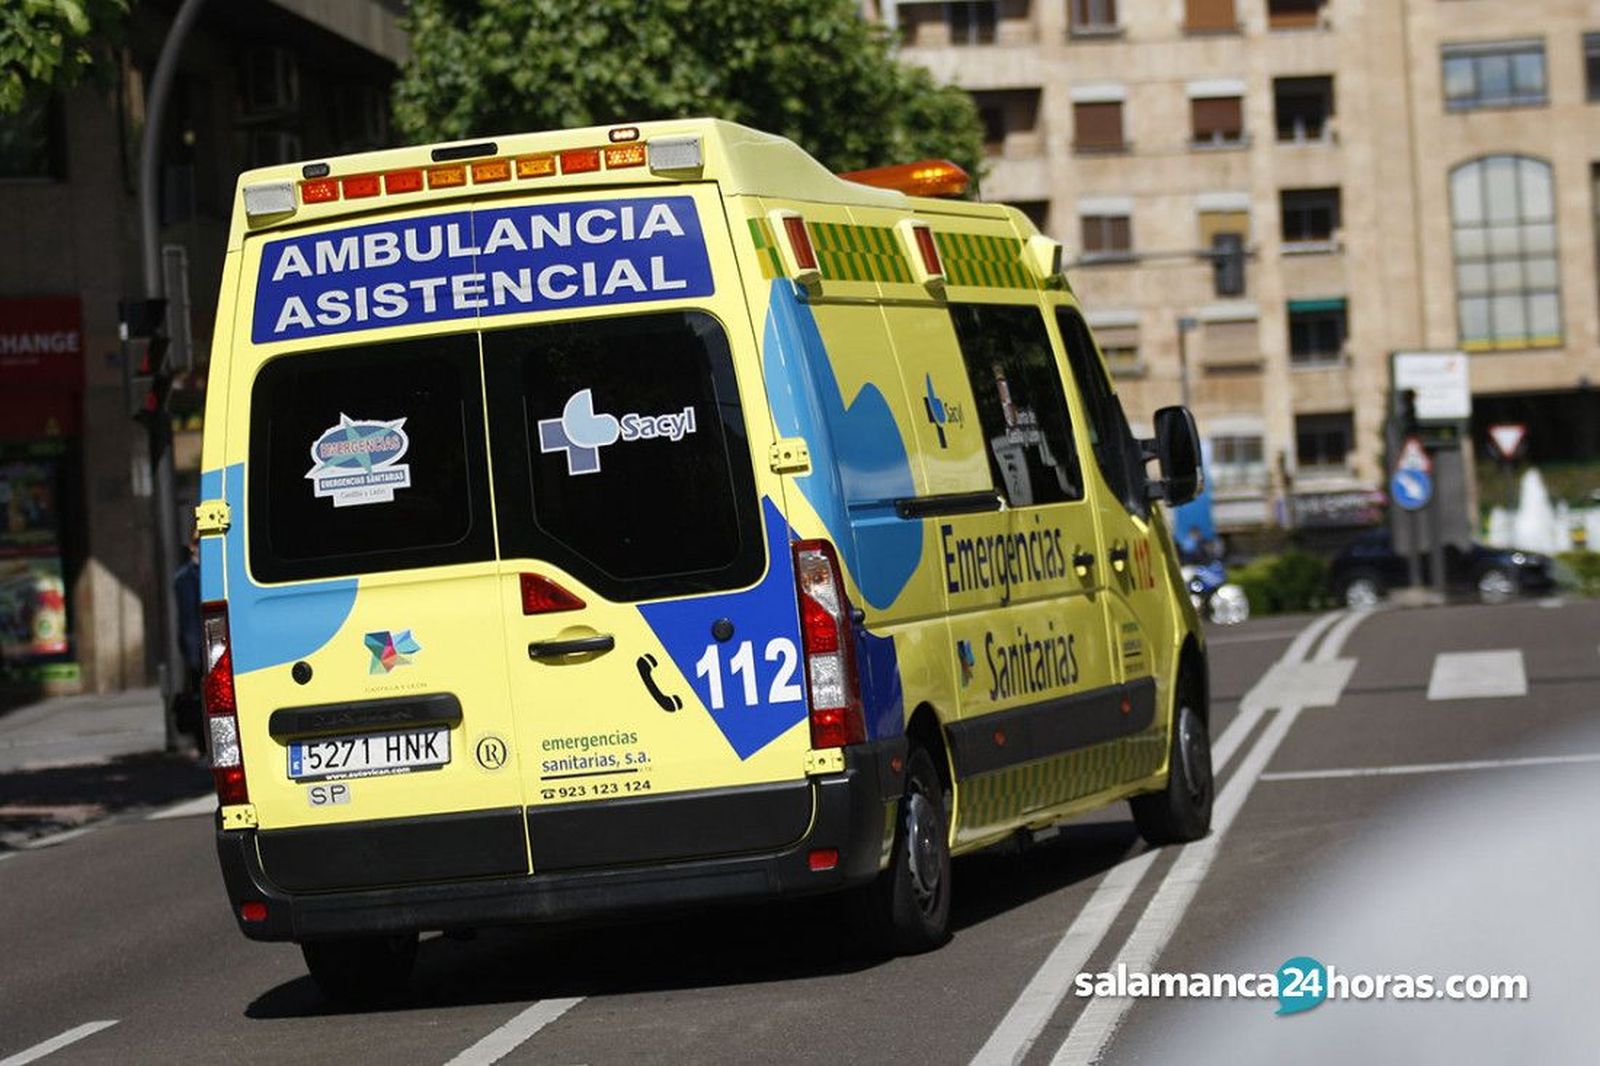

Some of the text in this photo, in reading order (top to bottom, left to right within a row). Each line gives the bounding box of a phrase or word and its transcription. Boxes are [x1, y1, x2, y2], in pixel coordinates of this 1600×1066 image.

[272, 203, 686, 282] AMBULANCIA
[274, 255, 688, 334] ASISTENCIAL
[0, 332, 80, 354] HANGE
[621, 407, 696, 441] Sacyl
[319, 436, 401, 459] EMERGENCIAS
[941, 514, 1065, 607] Emergencias
[696, 637, 802, 709] 112
[985, 620, 1079, 701] Sanitarias
[307, 732, 439, 770] 5271 HNK
[541, 730, 638, 752] emergencias
[541, 751, 652, 773] sanitarias, s.a.
[311, 784, 346, 805] SP
[558, 779, 652, 798] 923 123 124
